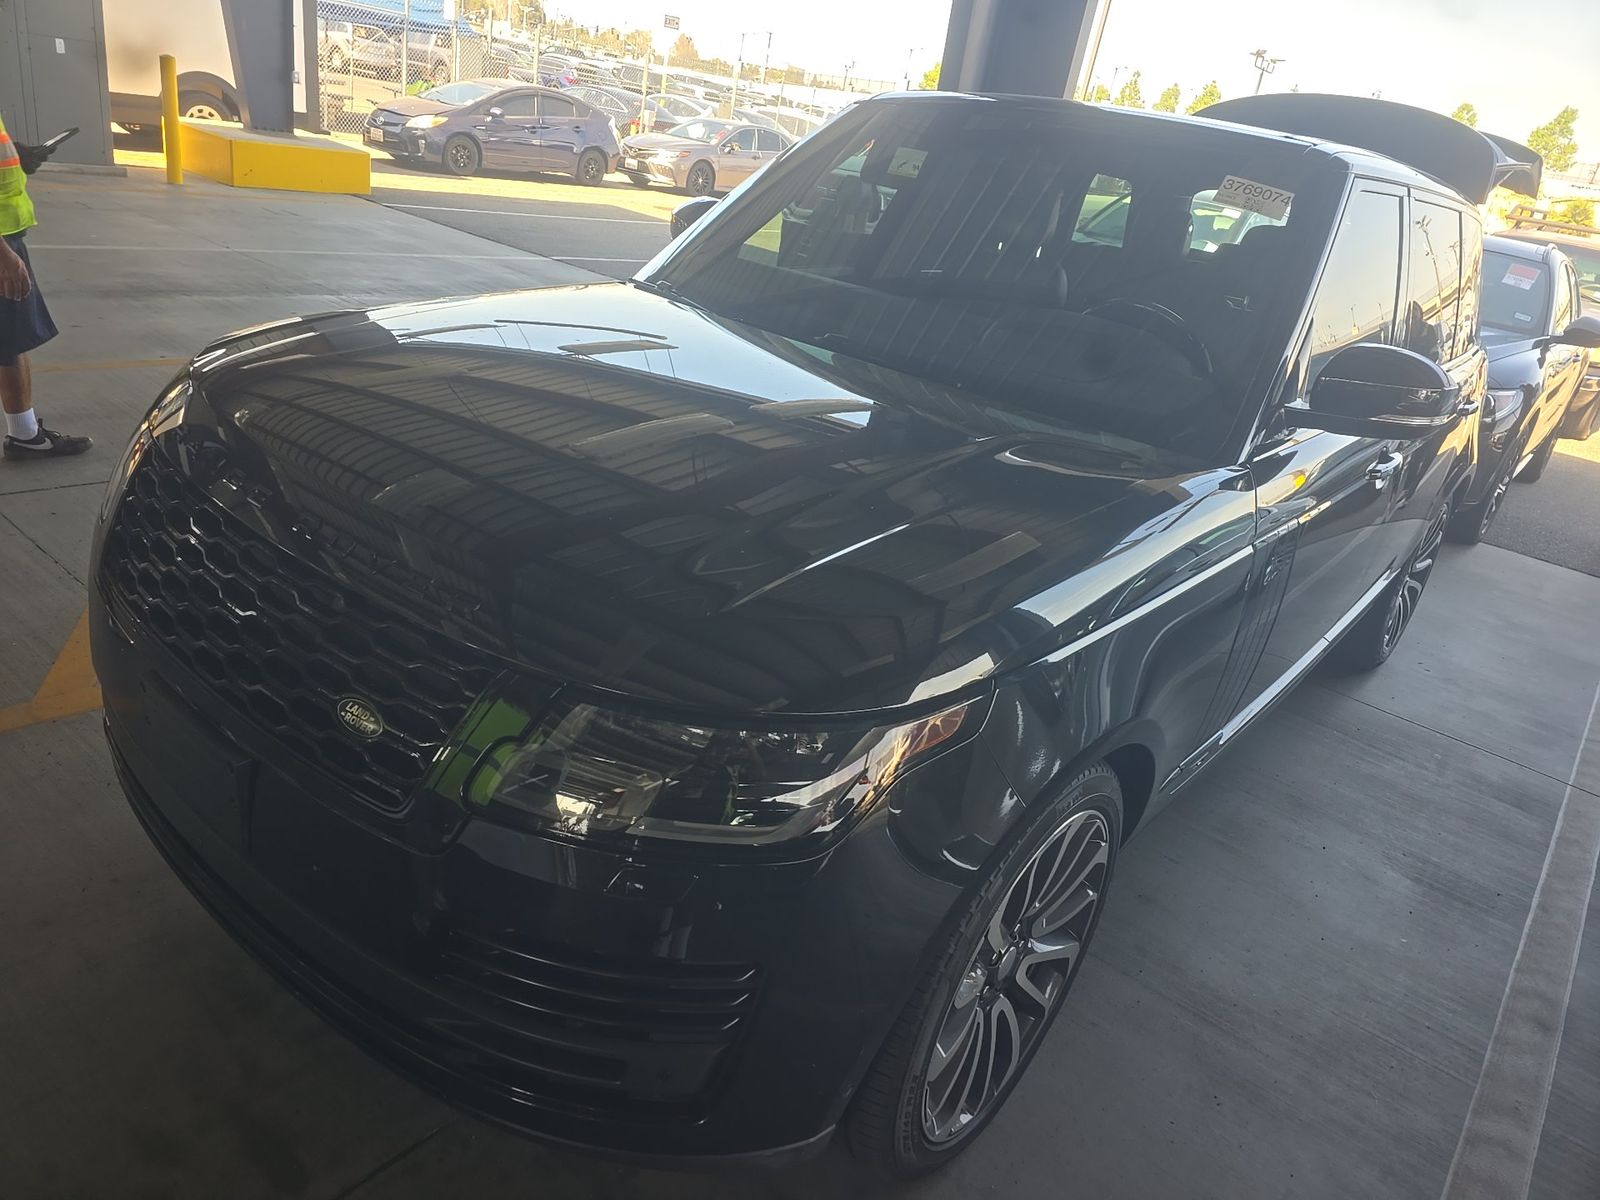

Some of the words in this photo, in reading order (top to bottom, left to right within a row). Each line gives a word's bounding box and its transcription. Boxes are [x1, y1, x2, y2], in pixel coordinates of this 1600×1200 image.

[1223, 179, 1291, 206] 3769074
[345, 702, 370, 720] LAND
[344, 712, 374, 734] ROVER
